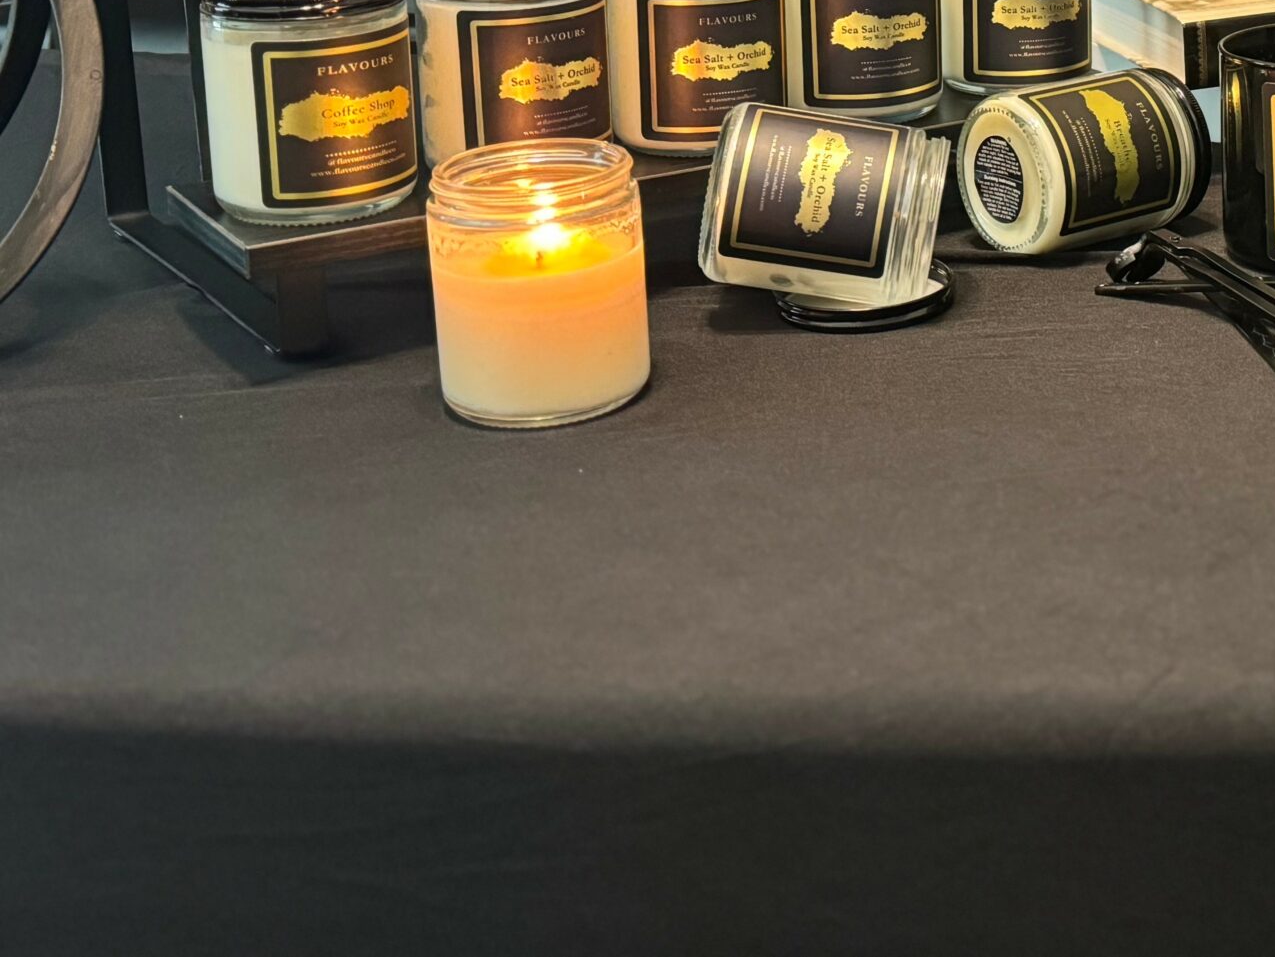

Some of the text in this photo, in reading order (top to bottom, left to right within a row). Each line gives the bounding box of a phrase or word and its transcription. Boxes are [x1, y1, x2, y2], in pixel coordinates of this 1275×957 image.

[1020, 5, 1038, 13] Salt
[1050, 1, 1074, 11] Orchid
[700, 13, 757, 26] FLAVOURS
[841, 26, 858, 34] Sea
[862, 24, 880, 33] Salt
[893, 19, 921, 29] Orchid
[528, 28, 585, 45] FLAVOURS
[682, 55, 700, 64] Sea
[704, 53, 724, 63] Salt
[737, 48, 766, 60] Orchid
[318, 55, 394, 77] FLAVOURS
[511, 64, 596, 88] Sea Salt + Orchid
[322, 98, 395, 120] Coffee Shop
[825, 137, 835, 151] Sea
[821, 154, 832, 171] Salt
[856, 156, 873, 216] FLAVOURS
[812, 186, 825, 223] Orchid
